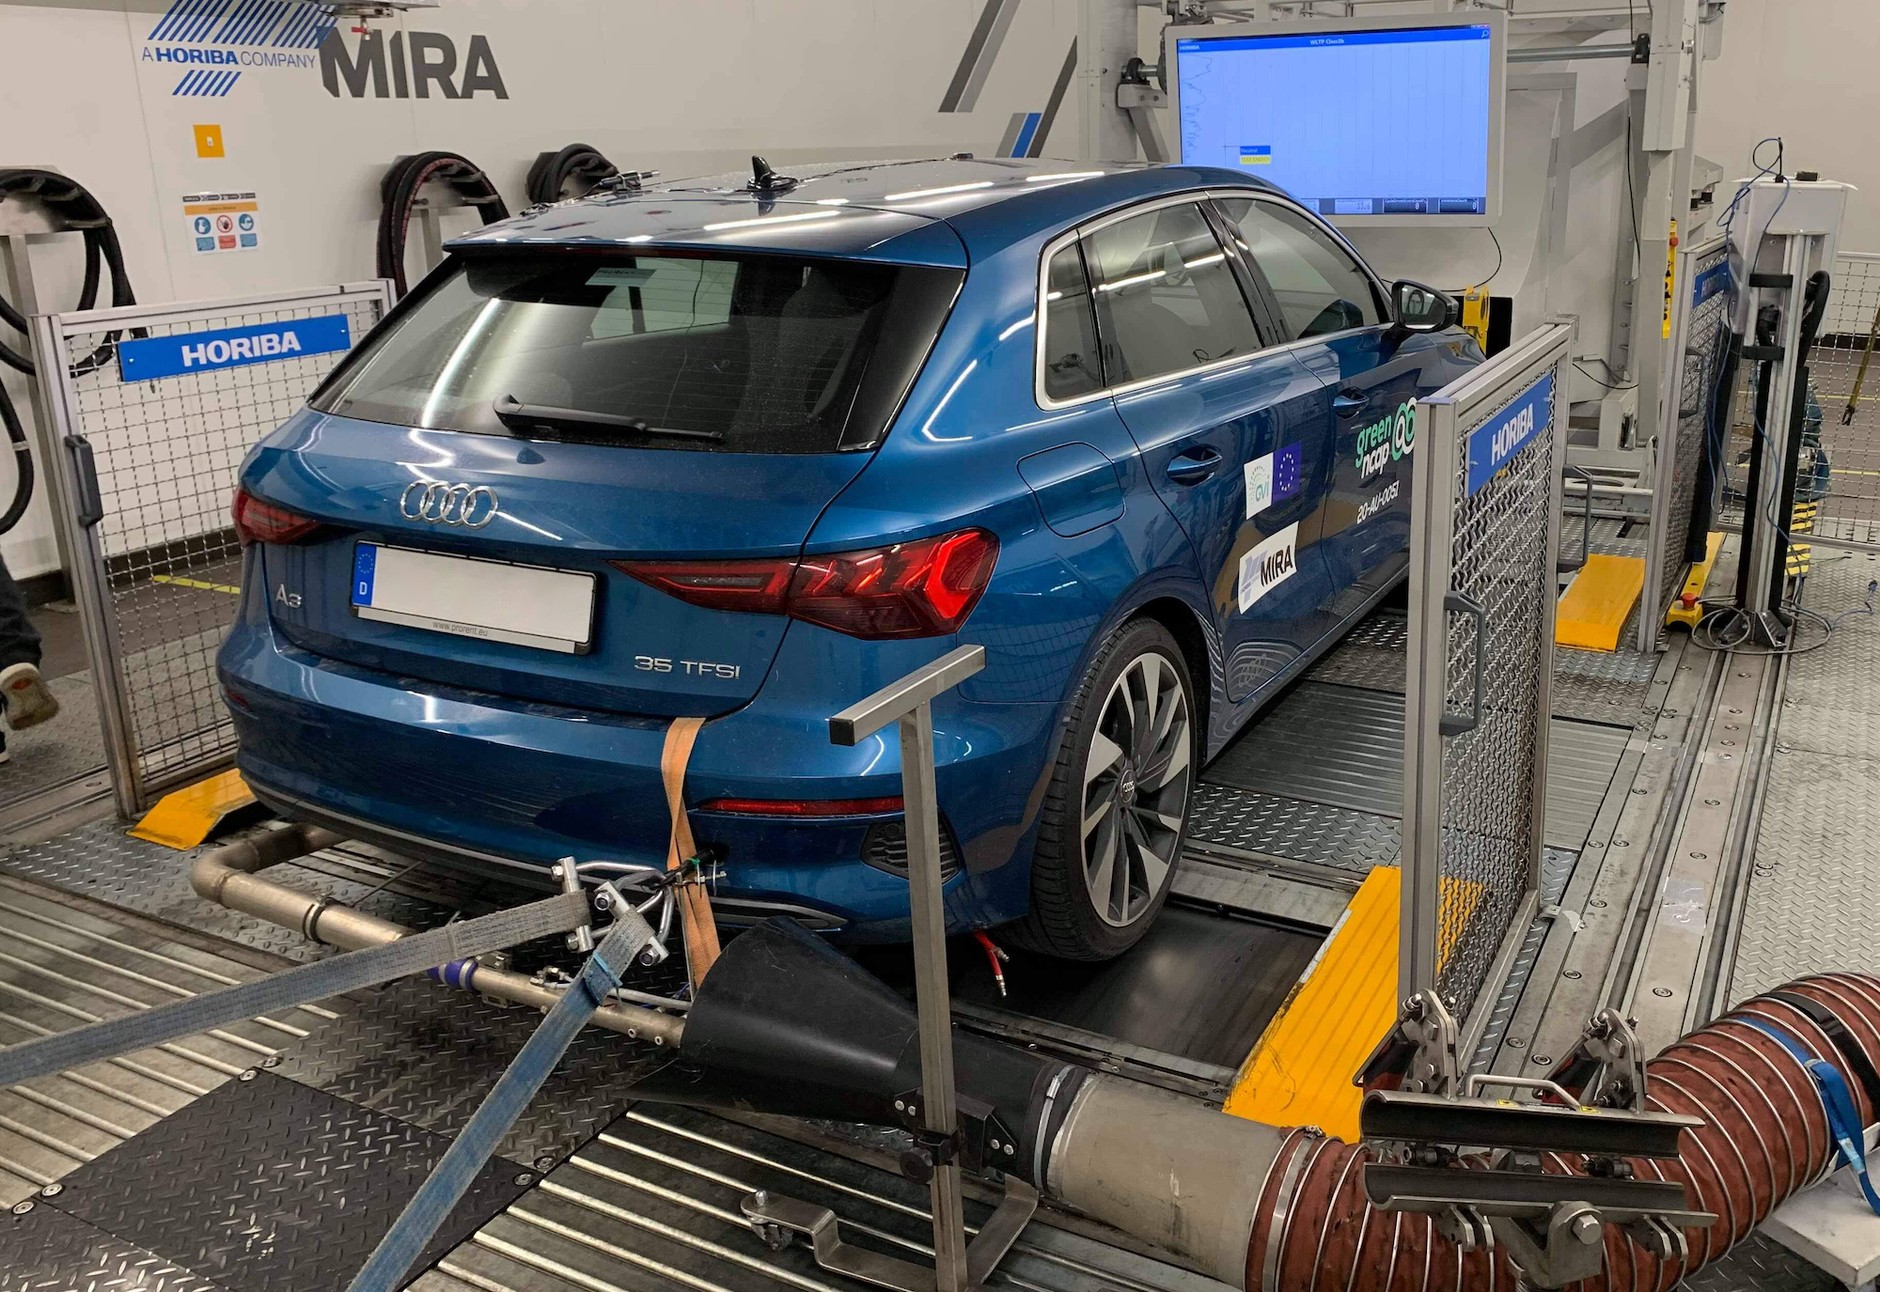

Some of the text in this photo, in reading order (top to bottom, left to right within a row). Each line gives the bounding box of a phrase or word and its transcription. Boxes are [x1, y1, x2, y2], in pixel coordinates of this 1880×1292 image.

[142, 46, 316, 69] A HORIBA COMPANY
[315, 26, 510, 100] MIRA
[181, 331, 301, 367] HORIBA
[1355, 414, 1392, 468] green
[1491, 402, 1534, 467] HORIBA
[1360, 441, 1390, 479] ncap
[1260, 544, 1293, 587] MIRA
[276, 583, 301, 609] A3
[359, 581, 367, 595] D
[634, 655, 740, 680] 35 TFSI
